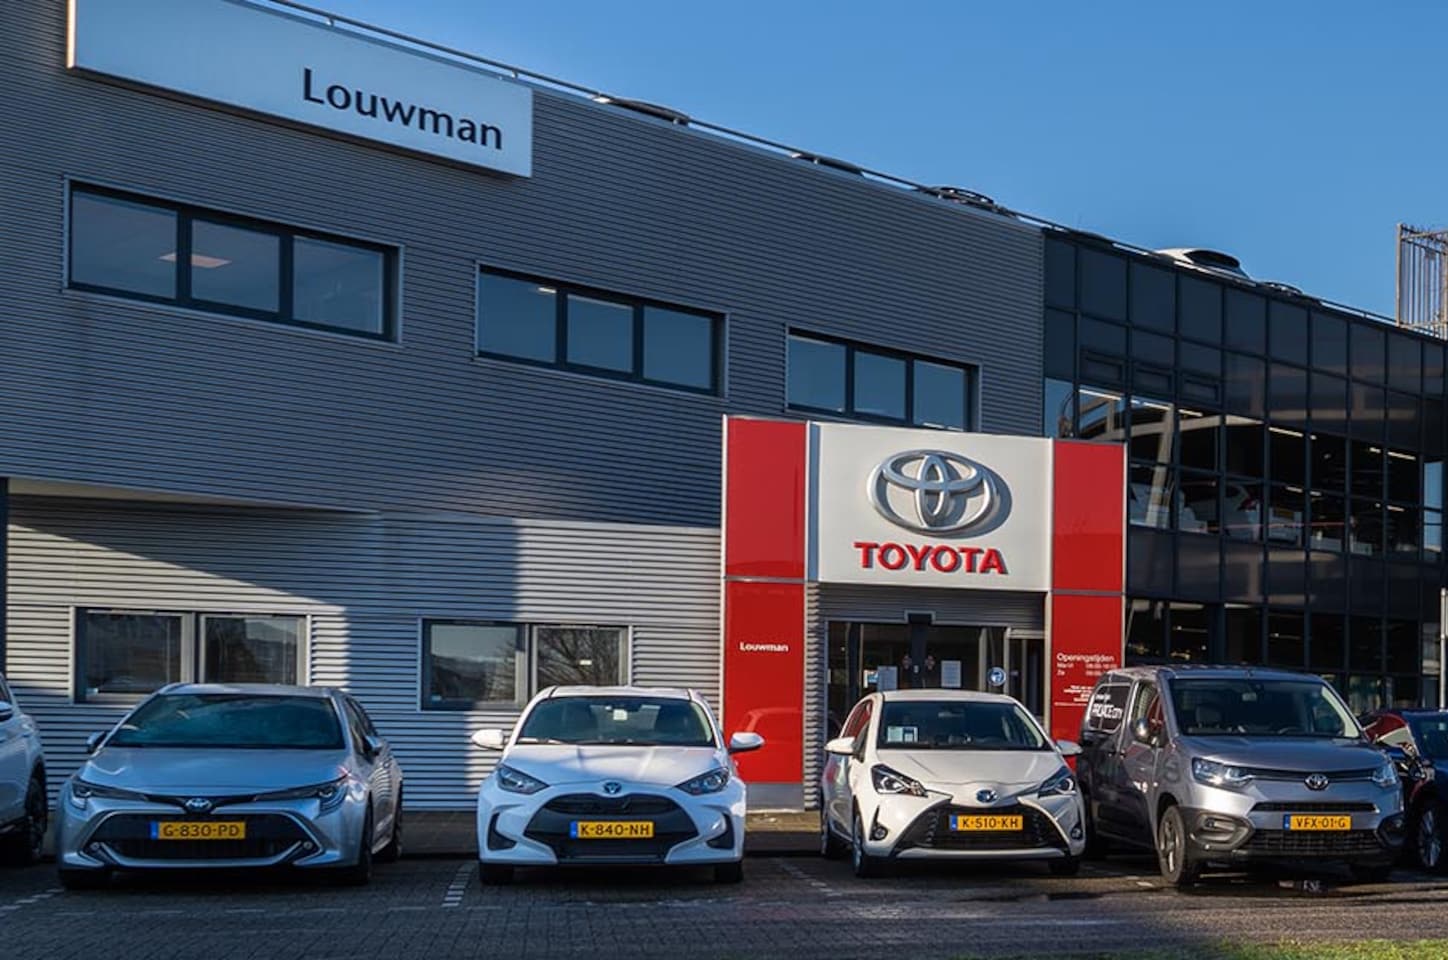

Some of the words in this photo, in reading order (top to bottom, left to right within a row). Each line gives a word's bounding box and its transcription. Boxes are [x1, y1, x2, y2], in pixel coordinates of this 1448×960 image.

[303, 67, 503, 150] Louwman
[853, 541, 1008, 575] TOYOTA
[739, 641, 789, 652] Louwman
[1056, 652, 1115, 663] Openingstijden
[962, 817, 1019, 829] K-510-KH
[1295, 817, 1347, 828] VFX-01-G
[162, 824, 240, 837] G-830-PD
[580, 823, 651, 836] K-840-NH
